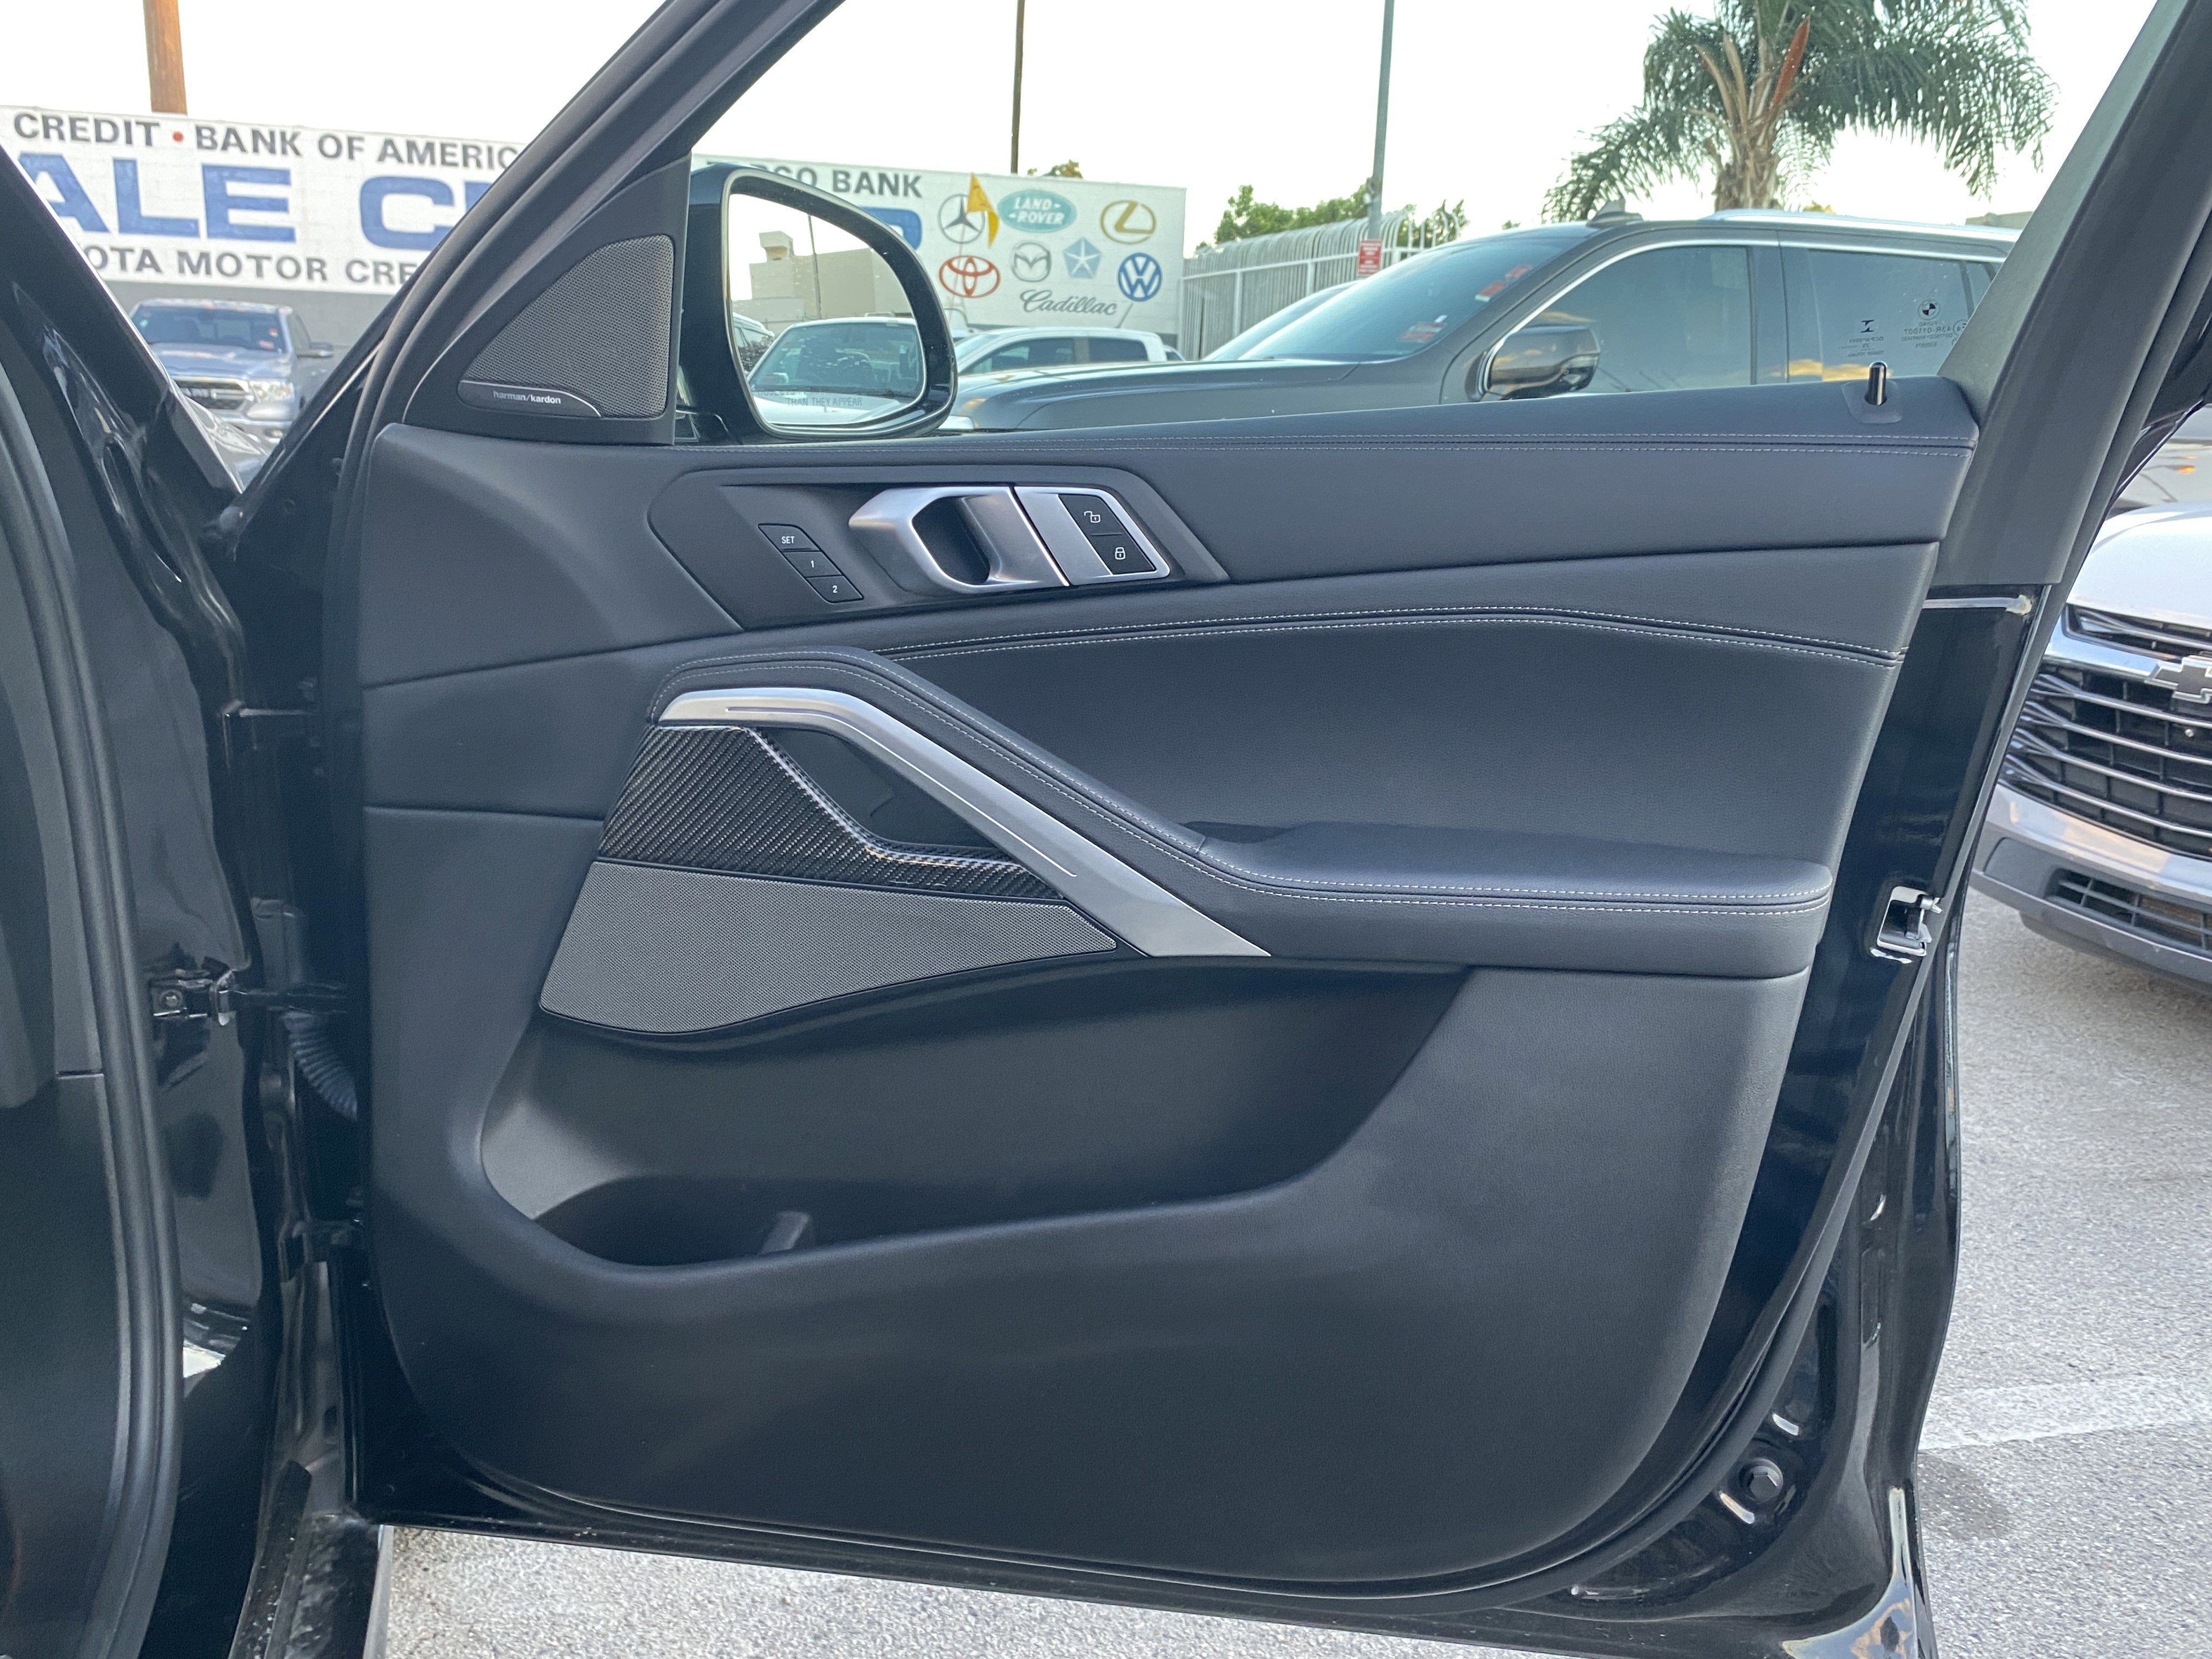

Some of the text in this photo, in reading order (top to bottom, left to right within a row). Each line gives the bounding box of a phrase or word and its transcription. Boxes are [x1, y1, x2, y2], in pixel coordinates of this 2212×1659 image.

[14, 112, 160, 146] CREDIT
[195, 125, 519, 170] BANK OF AMERIC
[832, 169, 923, 198] BANK
[359, 175, 495, 251] C
[83, 245, 418, 285] OTA MOTOR CRE
[1020, 289, 1118, 316] Cadillac
[493, 390, 561, 404] harman/kardon
[786, 397, 863, 407] THAN THEY APPEAR
[781, 536, 795, 544] SET
[810, 560, 815, 568] 1
[832, 585, 838, 594] 2
